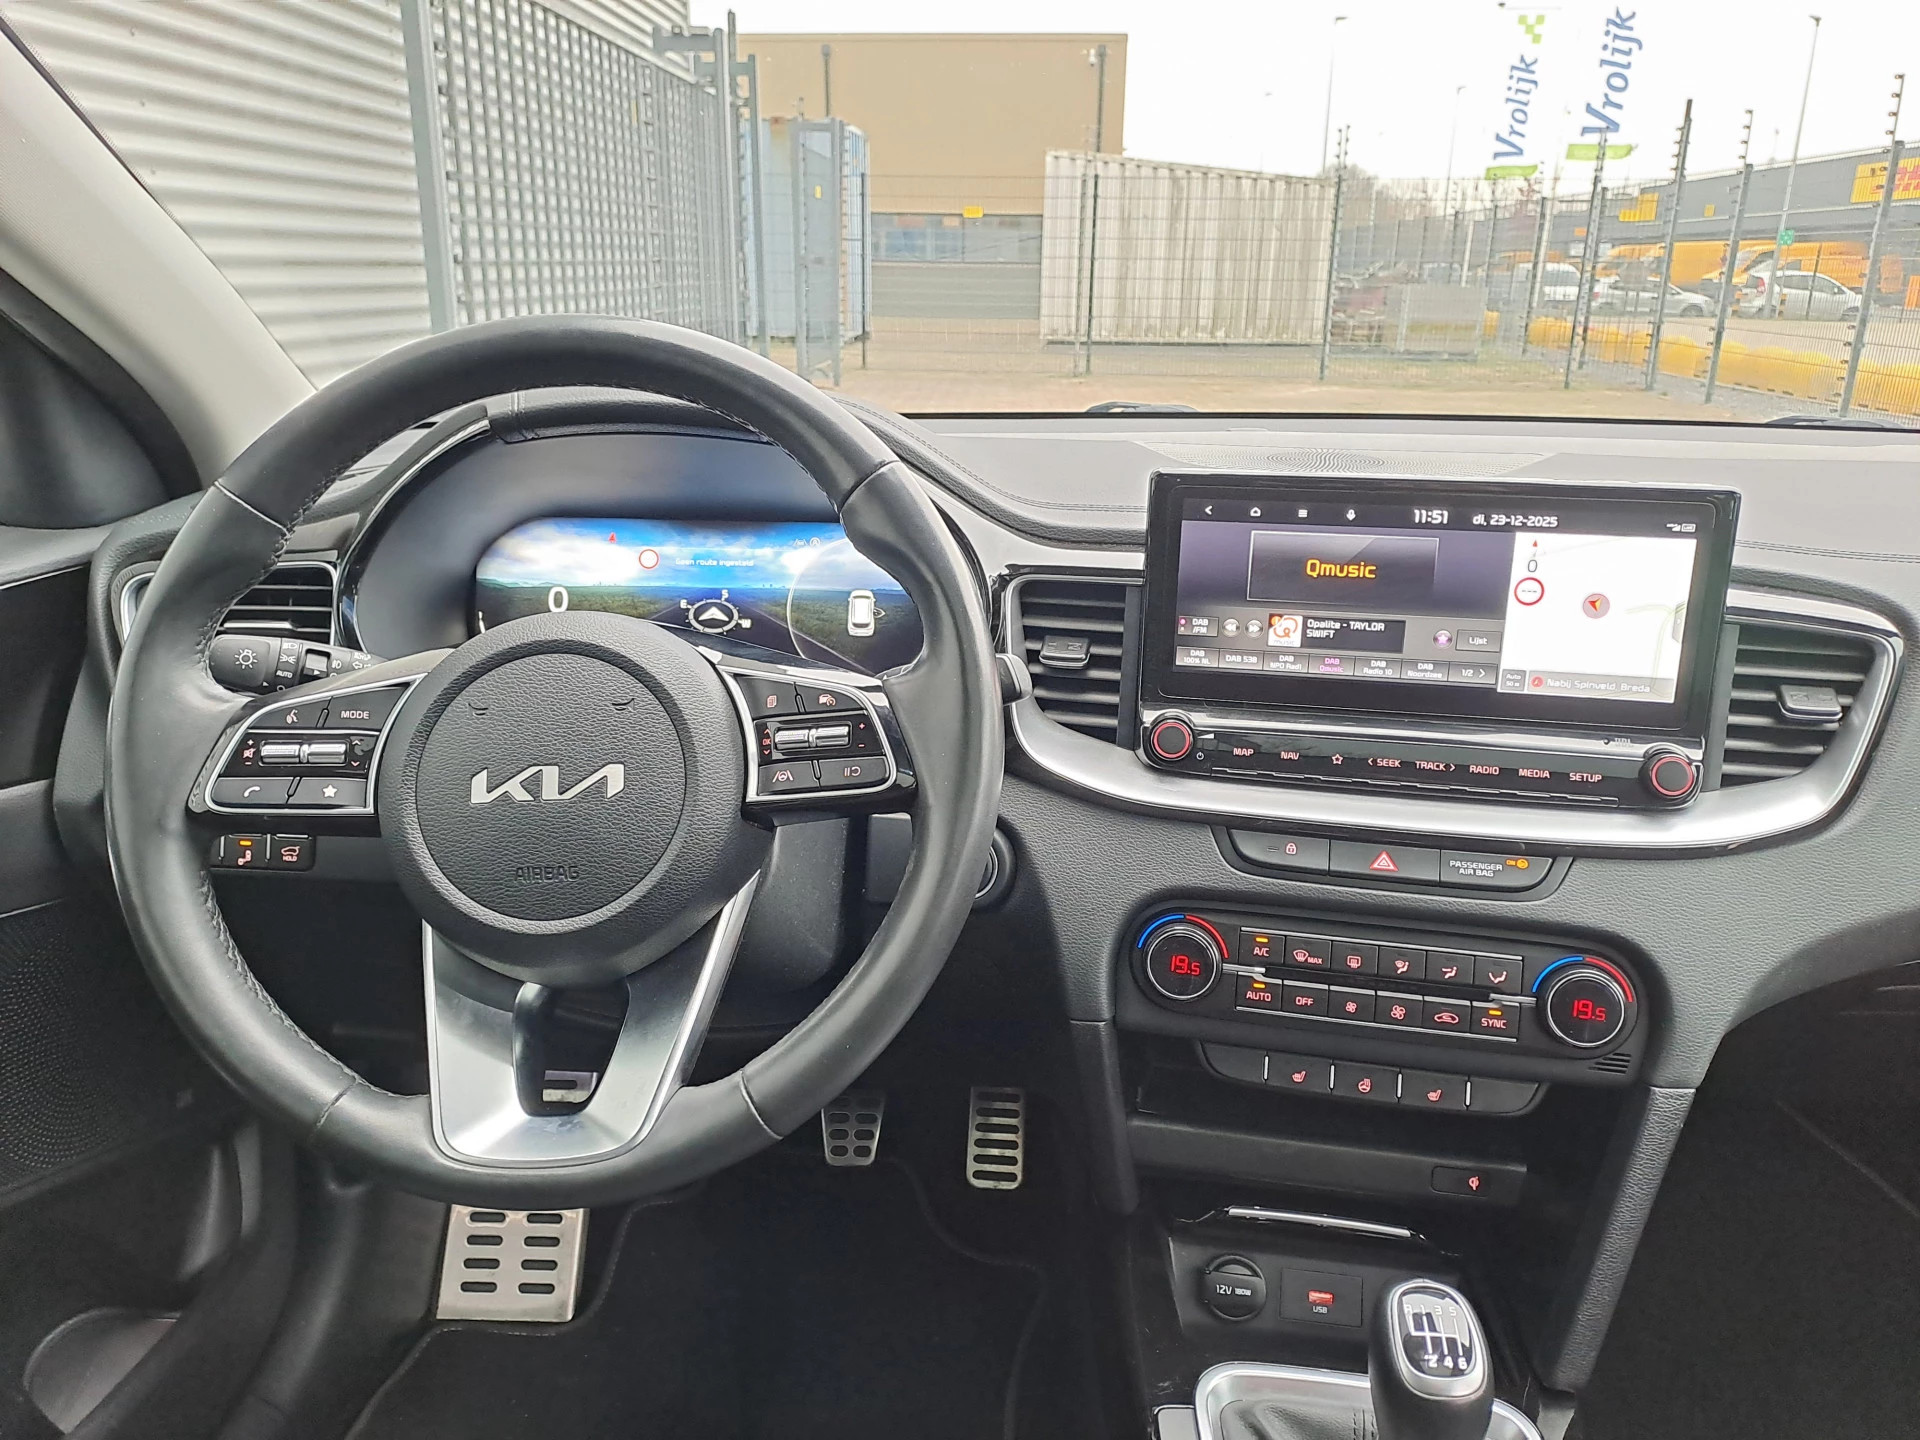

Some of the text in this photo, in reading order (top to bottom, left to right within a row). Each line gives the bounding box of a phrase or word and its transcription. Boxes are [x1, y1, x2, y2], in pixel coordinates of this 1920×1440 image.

[1580, 6, 1643, 137] Vrolijk
[1493, 54, 1538, 160] Vrolijk
[1414, 509, 1449, 524] 11:51
[1472, 514, 1558, 528] di, 23-12-2025
[1306, 559, 1377, 578] Qmusic
[548, 586, 569, 613] 0
[1192, 618, 1208, 626] DAB
[1306, 619, 1341, 630] Opalite
[1349, 621, 1385, 632] TAYLOR
[1306, 629, 1336, 639] SWIFT
[1469, 636, 1488, 646] Lijst
[1226, 654, 1242, 663] DAB
[1320, 664, 1344, 673] Qmusic
[1418, 662, 1434, 670] DAB
[276, 670, 292, 678] AUTO
[1407, 670, 1442, 679] Noordzee
[1461, 668, 1474, 677] 1/2
[1547, 678, 1572, 690] Nabij
[1620, 682, 1650, 693] Breda
[340, 710, 370, 720] MODE
[1233, 748, 1254, 757] MAP
[1280, 751, 1300, 760] NAV
[1376, 758, 1402, 768] SEEK
[1415, 760, 1446, 772] TRACK
[1469, 764, 1500, 775] RADIO
[1518, 768, 1550, 779] MEDIA
[1569, 772, 1602, 783] SETUP
[470, 763, 626, 804] KIA
[1450, 860, 1503, 871] PASSENGER
[513, 865, 580, 884] AIRBAG
[1253, 946, 1270, 957] A/C
[1170, 954, 1200, 976] 19.5
[1308, 956, 1323, 965] MAX
[1246, 990, 1272, 1002] AUTO
[1296, 996, 1314, 1006] OFF
[1572, 999, 1606, 1022] 19.5
[1481, 1017, 1507, 1029] SYNC
[1216, 1284, 1252, 1296] 12V 180W
[1312, 1305, 1328, 1314] USB
[1443, 1356, 1454, 1369] 4
[1458, 1356, 1468, 1370] 6
